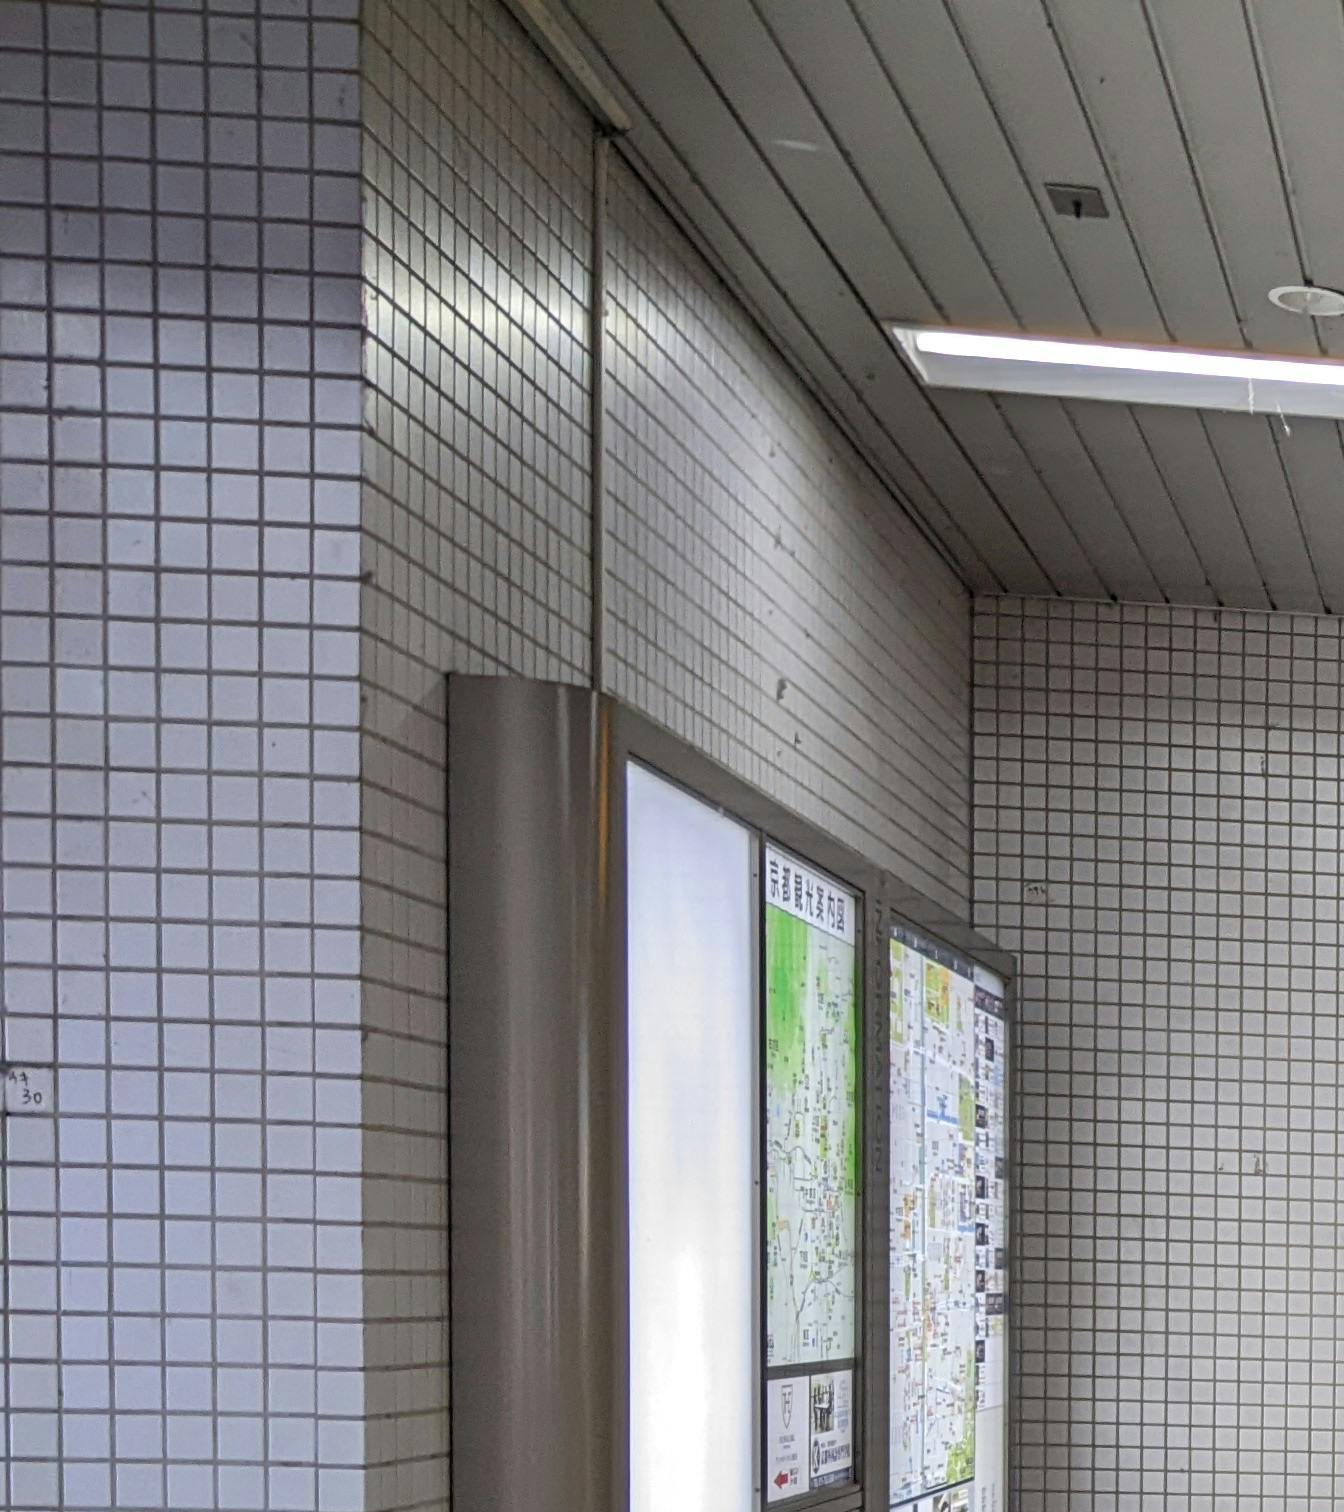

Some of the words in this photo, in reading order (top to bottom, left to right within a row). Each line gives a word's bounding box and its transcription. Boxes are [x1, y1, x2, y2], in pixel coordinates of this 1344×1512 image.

[769, 858, 845, 934] 京都観光案内図
